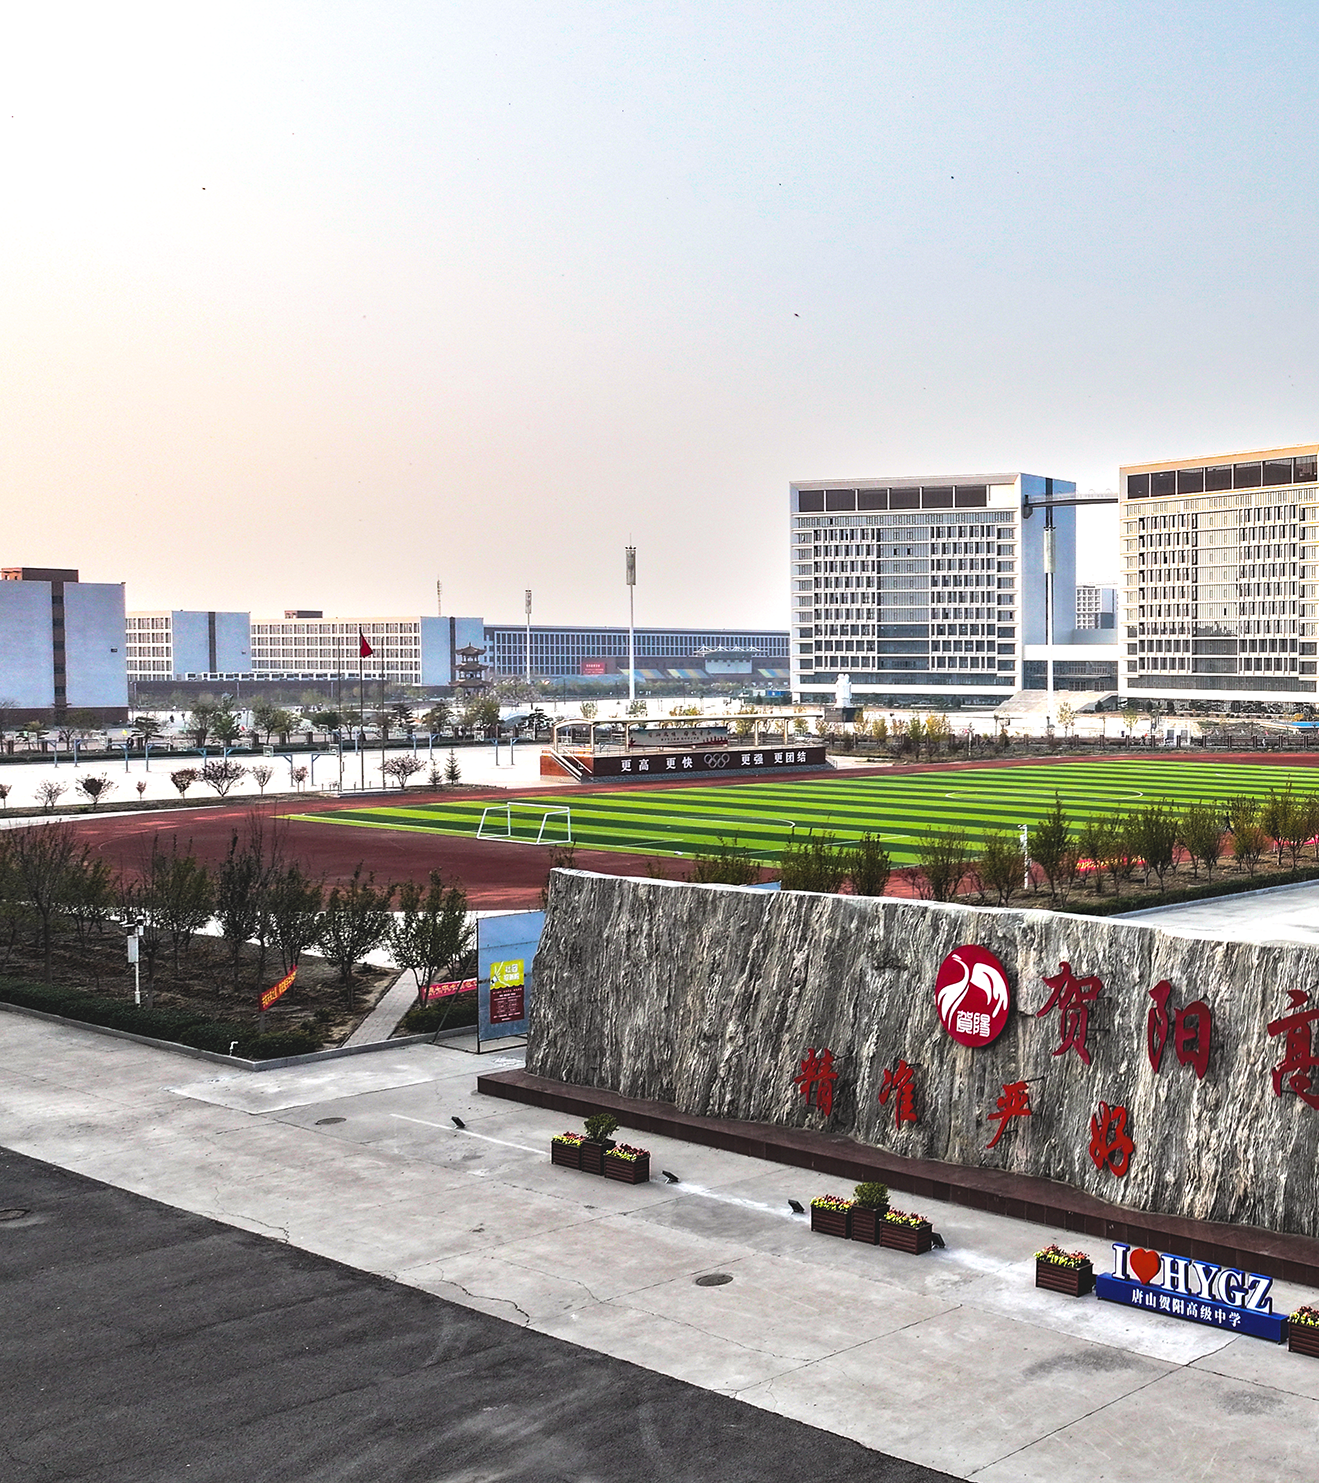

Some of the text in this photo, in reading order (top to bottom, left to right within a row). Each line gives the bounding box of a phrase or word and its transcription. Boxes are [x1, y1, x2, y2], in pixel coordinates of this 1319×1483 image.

[621, 750, 807, 772] 更高 更快 更强 更团结
[1112, 1242, 1272, 1315] I HYGZ
[1131, 1289, 1241, 1327] 唐山贺阳高级中学
